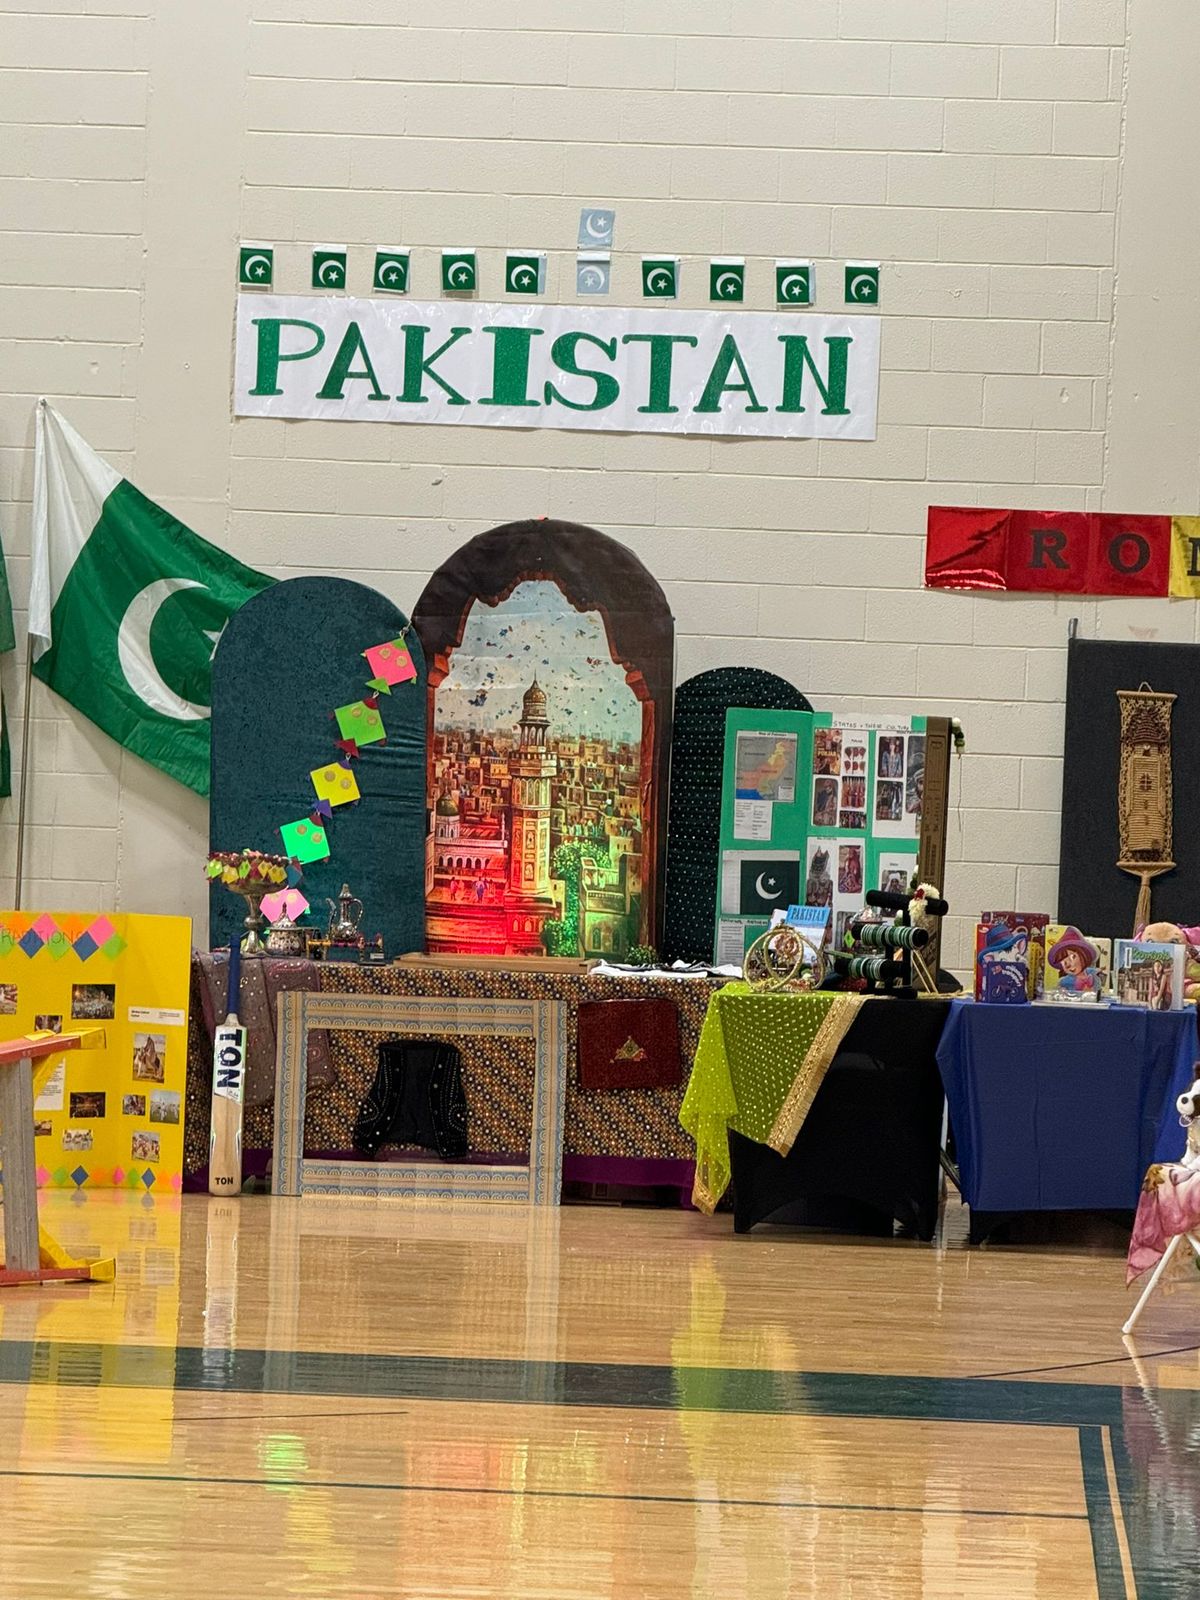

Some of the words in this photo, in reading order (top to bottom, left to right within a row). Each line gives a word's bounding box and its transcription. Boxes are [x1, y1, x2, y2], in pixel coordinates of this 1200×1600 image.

[247, 316, 854, 416] PAKISTAN
[791, 906, 826, 922] PAKISTAN
[217, 1029, 242, 1088] TON
[215, 1176, 234, 1185] TON
